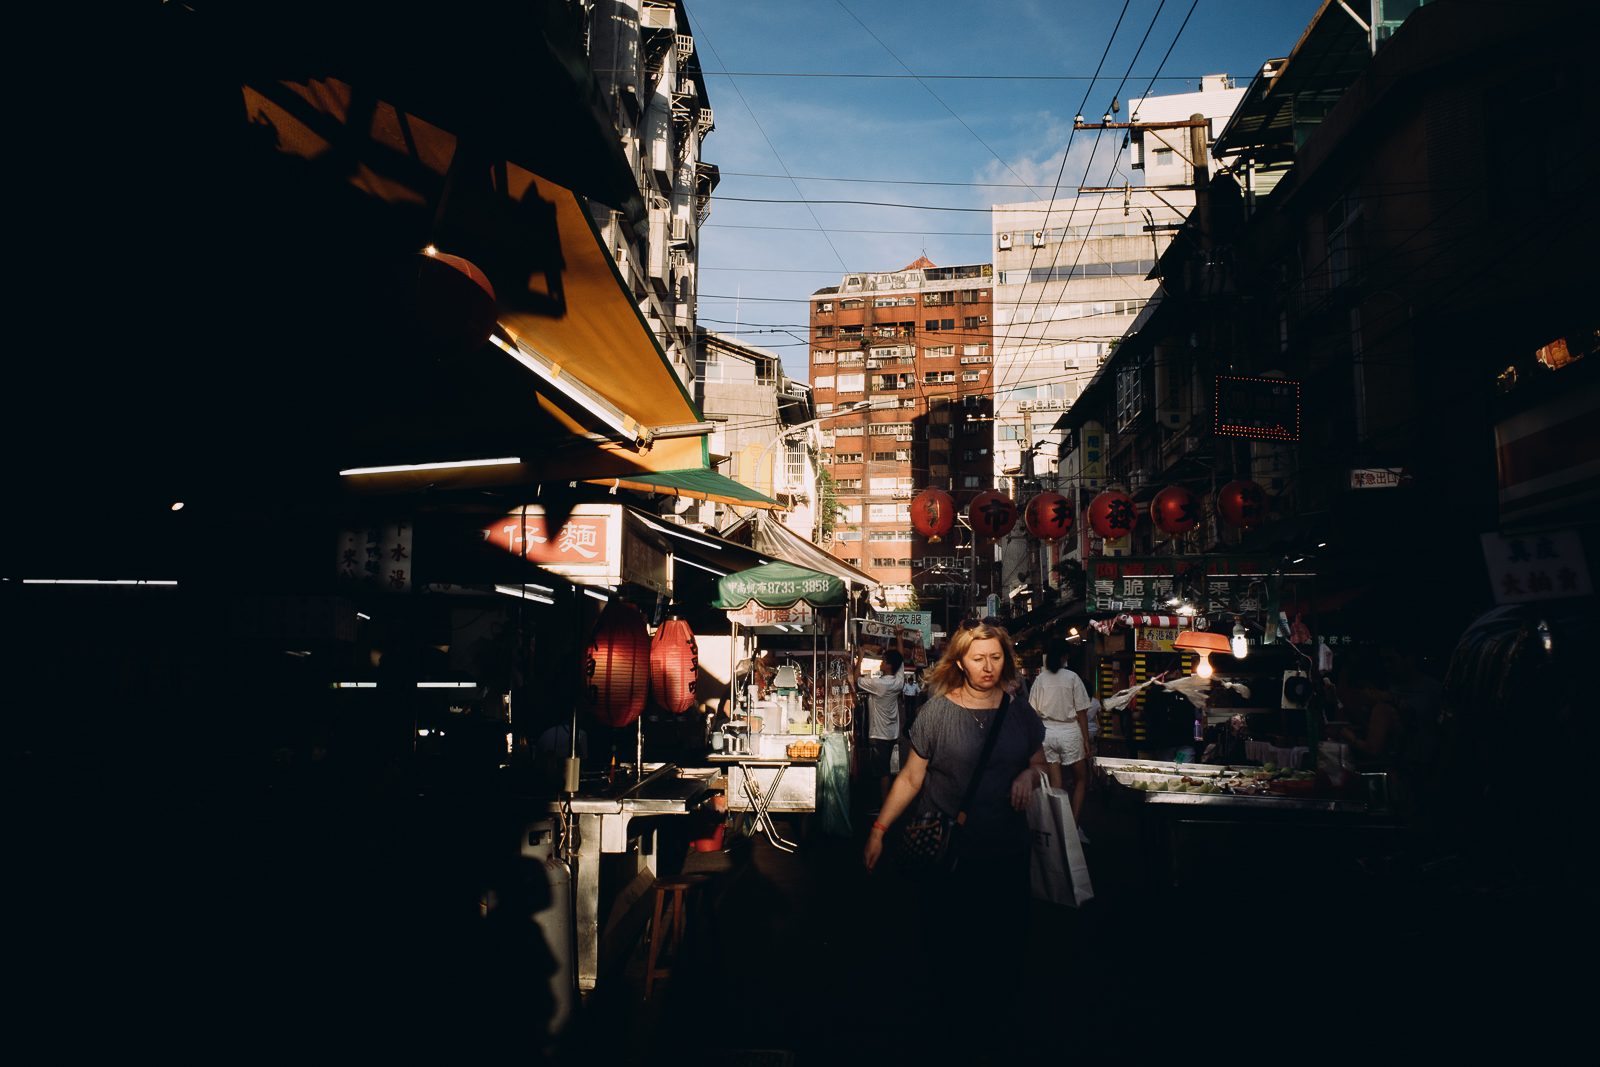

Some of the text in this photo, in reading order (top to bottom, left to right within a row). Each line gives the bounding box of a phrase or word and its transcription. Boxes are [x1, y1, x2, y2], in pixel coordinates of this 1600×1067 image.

[1354, 472, 1397, 486] 緊急出口
[979, 499, 1012, 532] 市
[1051, 499, 1074, 532] 利
[1105, 499, 1136, 531] 發
[1174, 493, 1200, 526] 大
[1508, 536, 1560, 564] 真皮
[1502, 567, 1578, 596] 大拍賣
[755, 608, 809, 623] 柳橙汁
